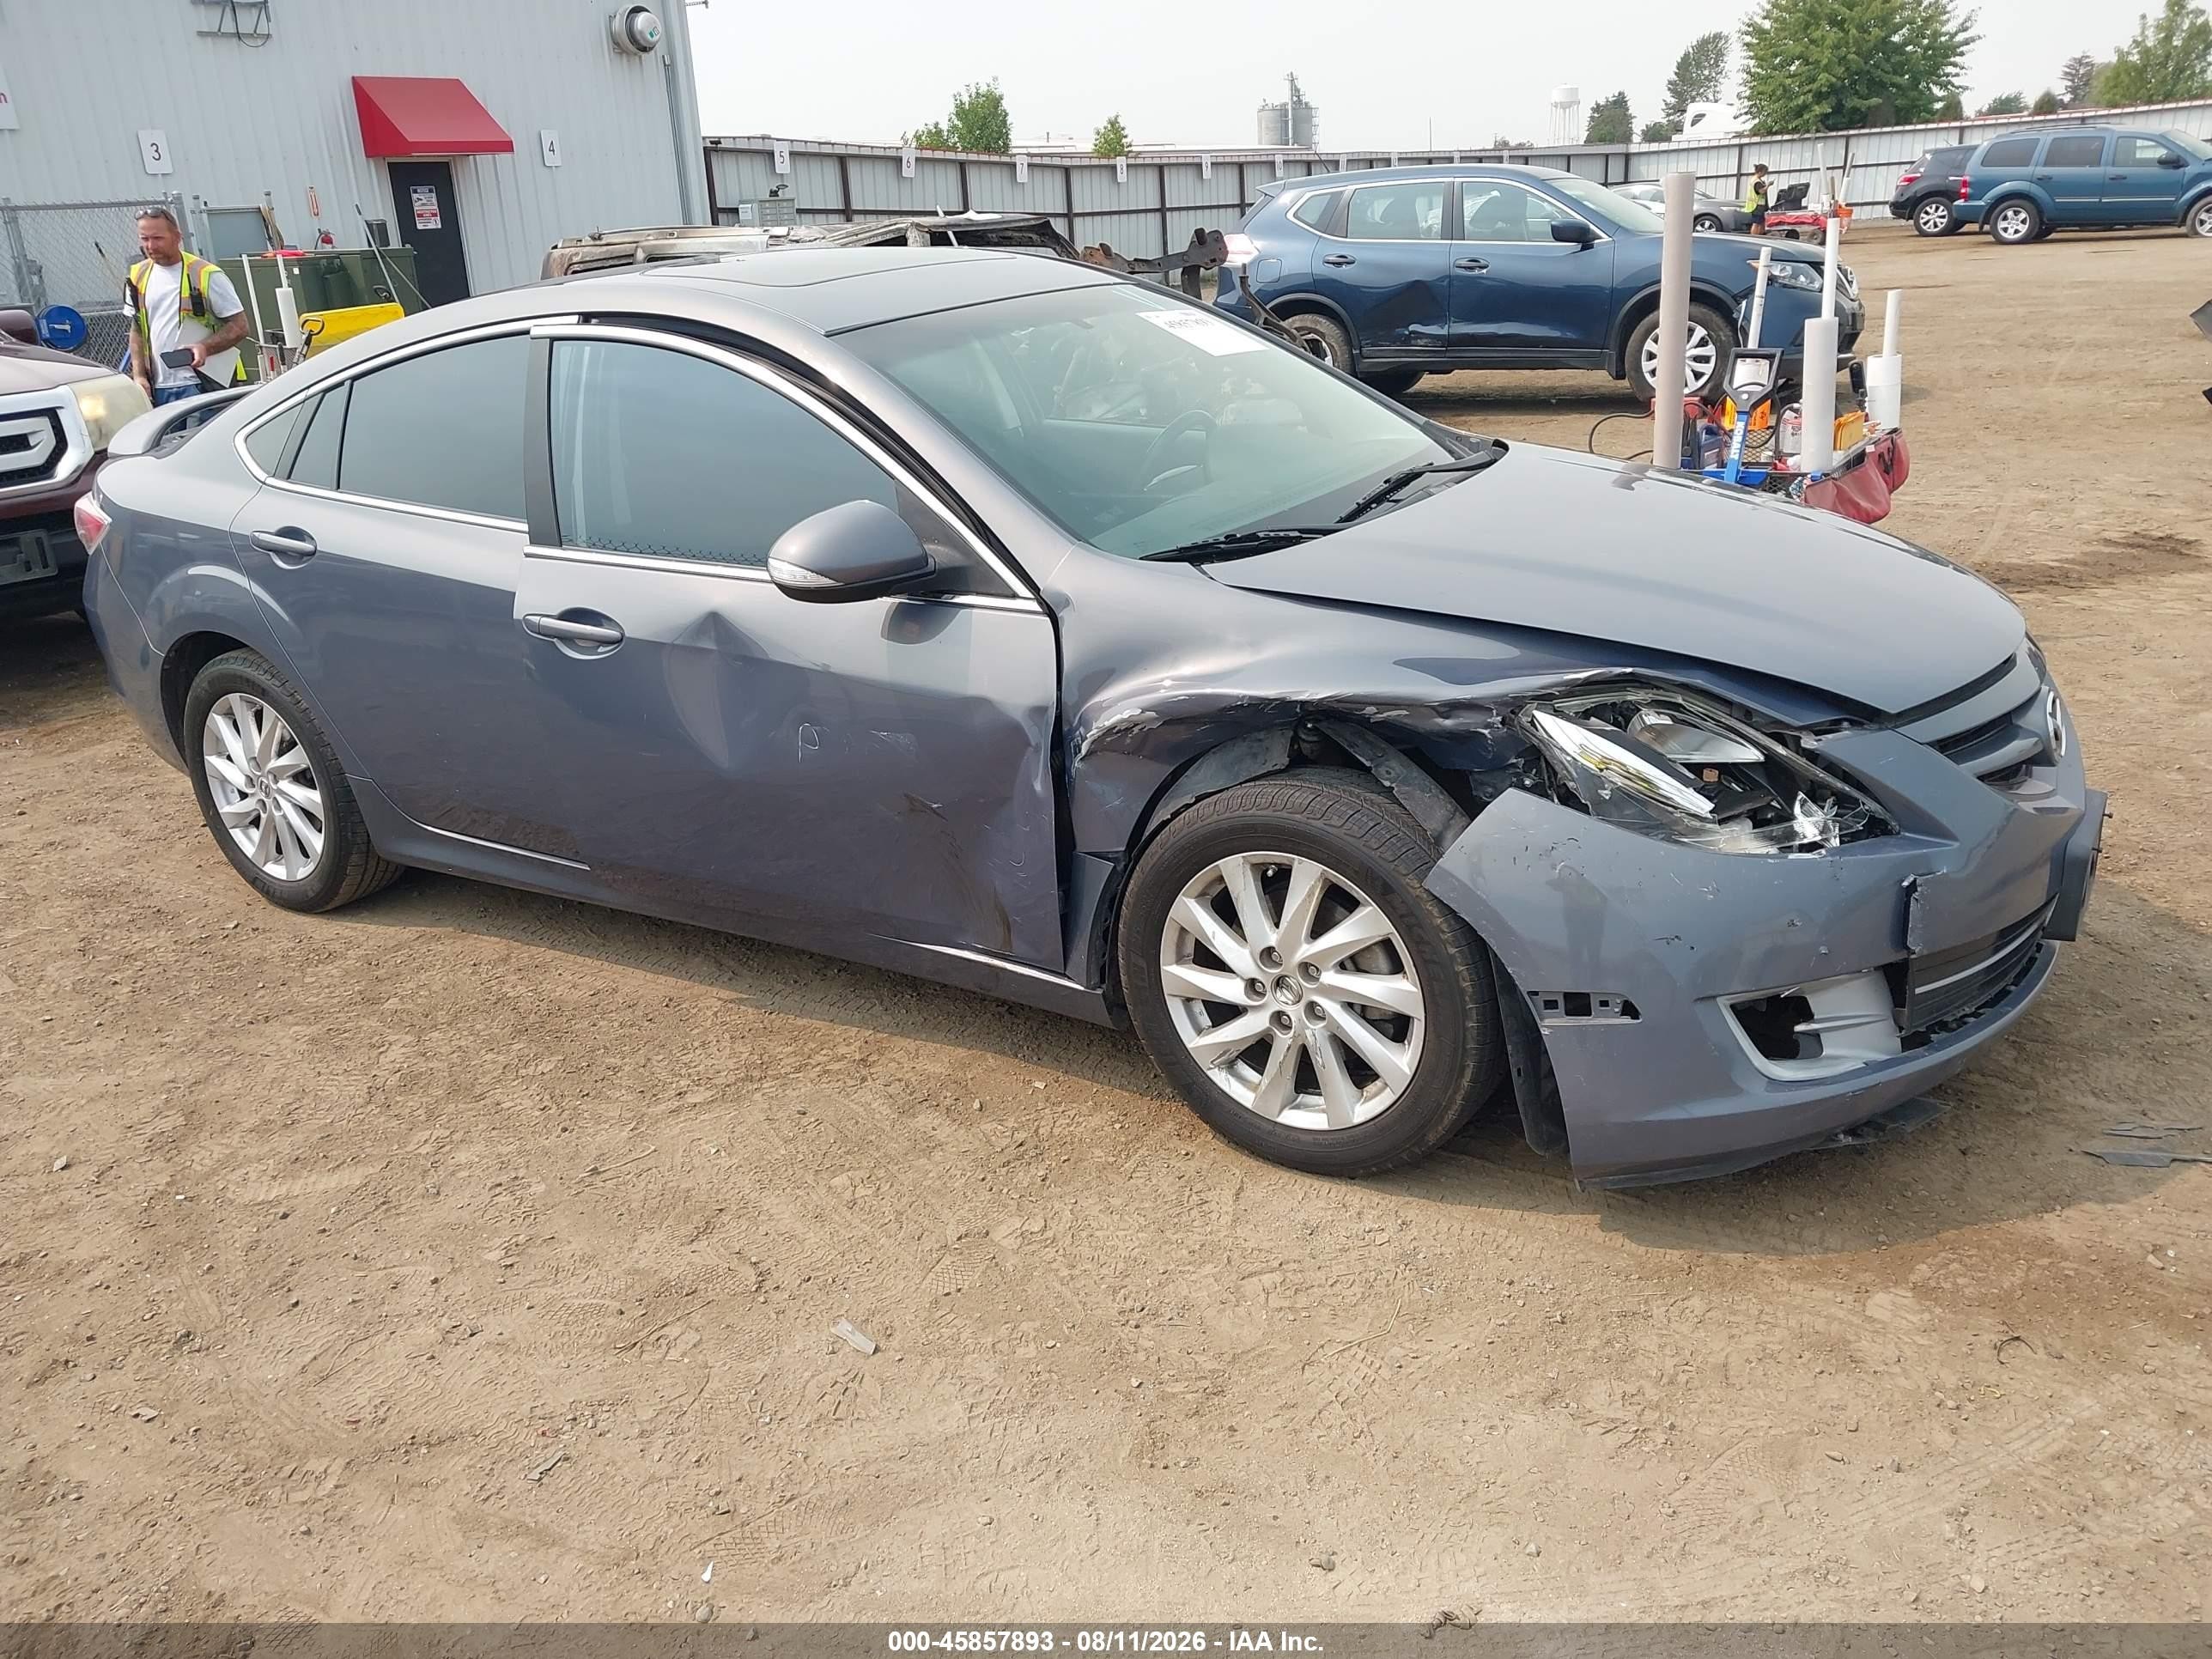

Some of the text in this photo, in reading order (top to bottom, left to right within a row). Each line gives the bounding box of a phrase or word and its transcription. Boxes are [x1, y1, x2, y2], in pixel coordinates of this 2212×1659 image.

[150, 143, 161, 161] 3
[548, 140, 556, 155] 4
[779, 150, 786, 164] 5
[906, 156, 912, 169] 6
[1019, 162, 1024, 174] 7
[1120, 163, 1124, 175] 8
[1205, 161, 1209, 172] 9
[1729, 421, 1746, 461] KOBALT
